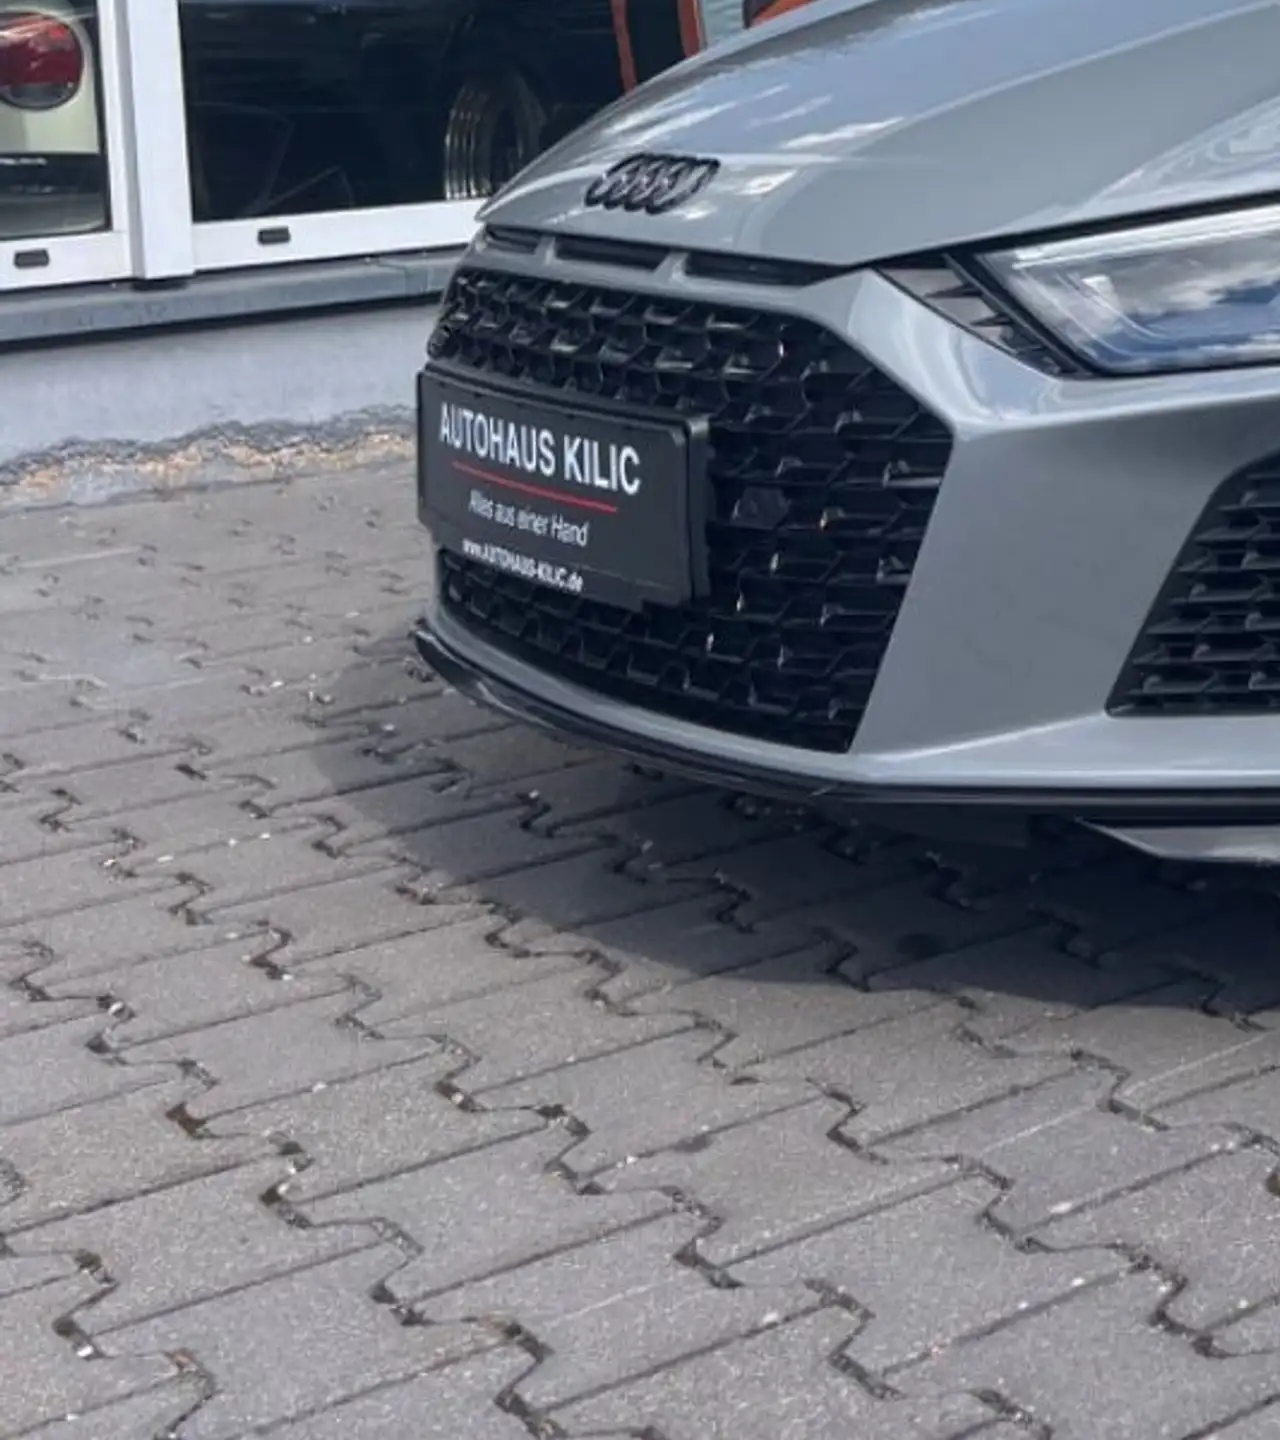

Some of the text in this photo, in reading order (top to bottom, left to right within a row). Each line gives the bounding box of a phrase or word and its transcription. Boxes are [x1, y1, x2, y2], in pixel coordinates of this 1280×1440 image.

[440, 402, 641, 495] AUTOHAUS KILIC
[468, 489, 590, 548] Alles aus einer Hand
